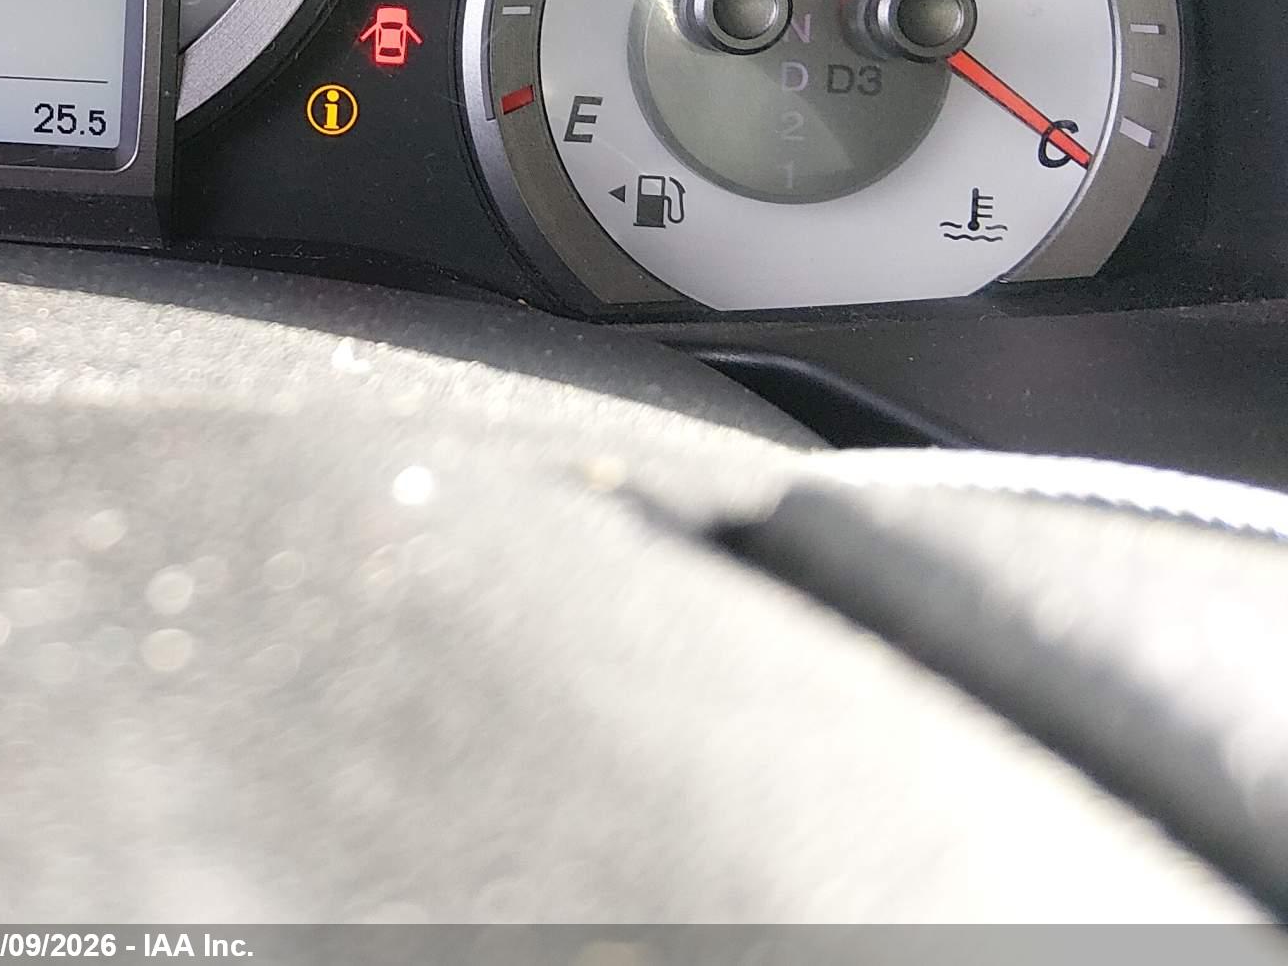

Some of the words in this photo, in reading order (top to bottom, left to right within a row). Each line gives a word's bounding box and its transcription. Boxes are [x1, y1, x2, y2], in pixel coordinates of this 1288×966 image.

[784, 13, 810, 44] N
[781, 61, 809, 91] D
[827, 63, 883, 96] D3
[34, 103, 106, 136] 25.5
[563, 96, 602, 143] E
[780, 110, 804, 140] 2
[1038, 120, 1079, 168] C
